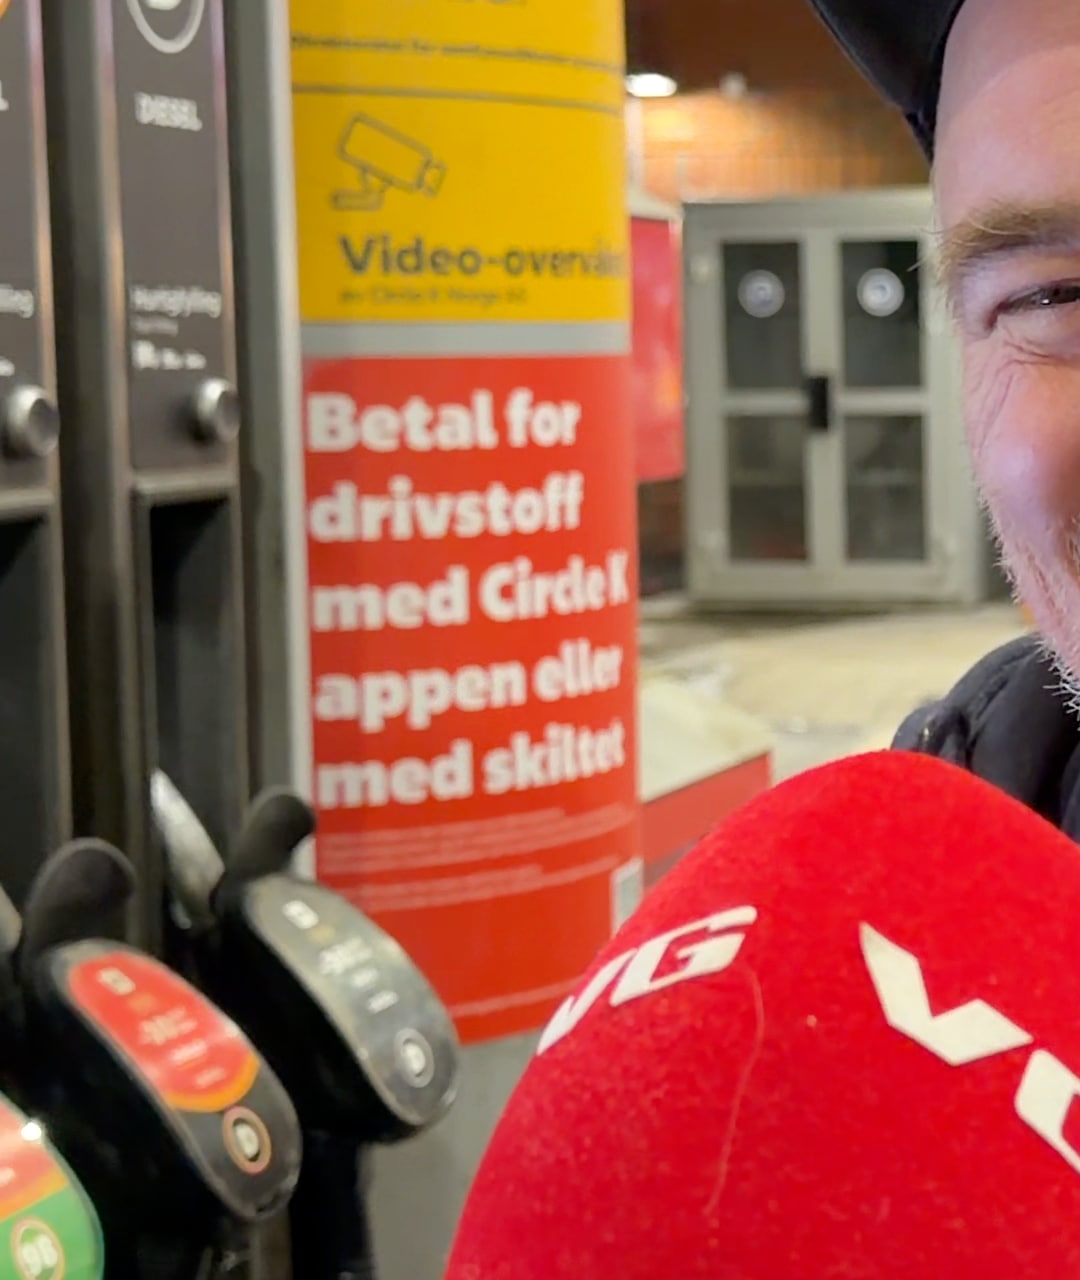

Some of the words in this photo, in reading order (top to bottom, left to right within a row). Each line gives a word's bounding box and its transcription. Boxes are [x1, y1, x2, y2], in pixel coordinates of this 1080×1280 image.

[306, 388, 498, 453] Betal
[504, 387, 581, 449] for
[308, 471, 585, 543] drivstoff
[311, 565, 471, 632] med
[314, 659, 527, 734] appen
[532, 638, 624, 703] eller
[315, 738, 474, 810] med
[480, 718, 626, 796] skiltet
[537, 905, 758, 1057] VG
